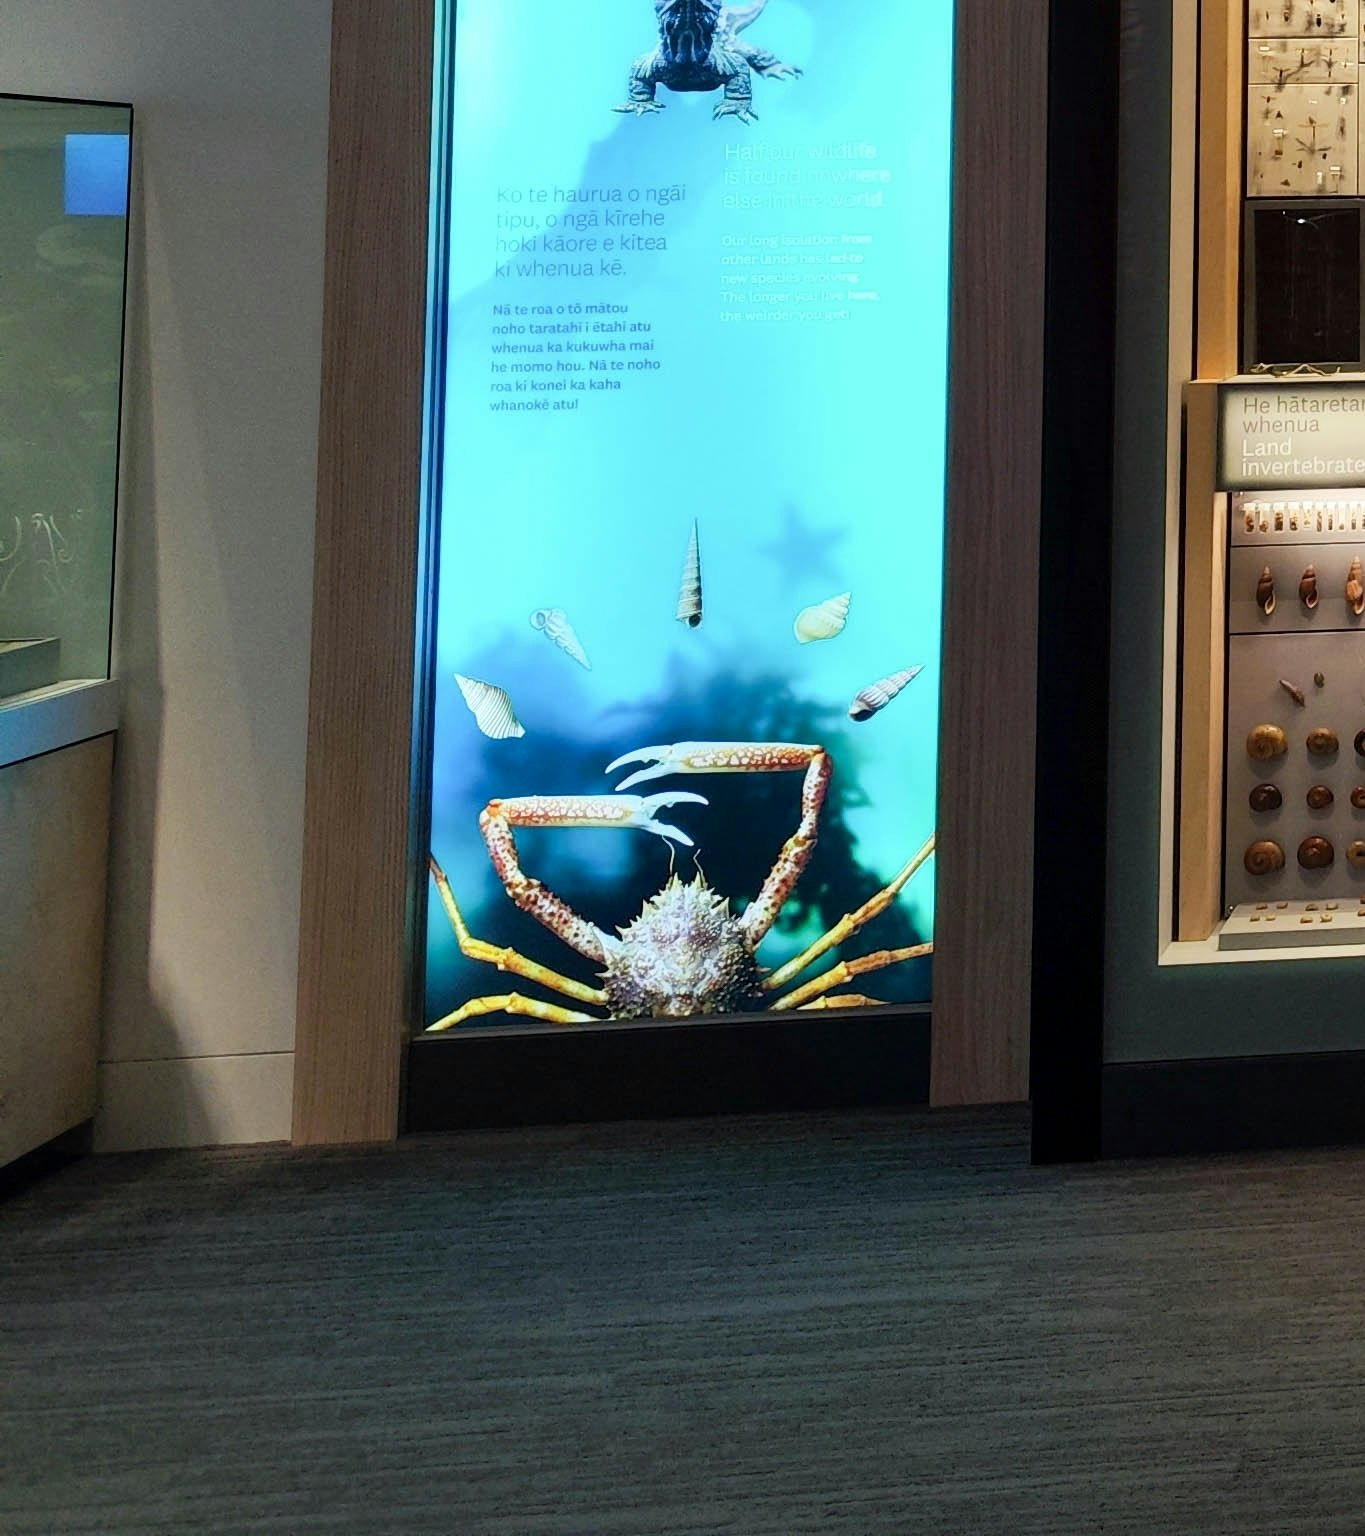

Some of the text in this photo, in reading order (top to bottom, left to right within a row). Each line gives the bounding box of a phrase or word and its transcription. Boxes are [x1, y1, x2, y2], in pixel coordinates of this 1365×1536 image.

[497, 184, 686, 206] Ko te haurua o ngāi
[497, 209, 665, 231] tipu, o ngā kīrehe
[496, 234, 667, 253] hoki kāore e kitea
[495, 259, 626, 278] ki whenua kē.
[493, 304, 510, 316] Nā
[515, 305, 528, 315] te
[531, 305, 552, 315] roa
[585, 303, 628, 314] mātou
[492, 323, 525, 335] noho
[529, 322, 582, 334] taratahi
[592, 320, 626, 333] ētahi
[629, 322, 651, 332] atu
[492, 340, 654, 354] whenua ka kukuwha mai
[491, 361, 507, 373] he
[511, 362, 552, 372] momo
[610, 361, 624, 371] te
[627, 358, 661, 370] noho
[490, 378, 621, 392] roa ki konei ka kaha
[490, 399, 549, 411] whanokē
[1244, 397, 1270, 414] He
[1243, 416, 1320, 433] whenua
[1243, 438, 1292, 457] Land
